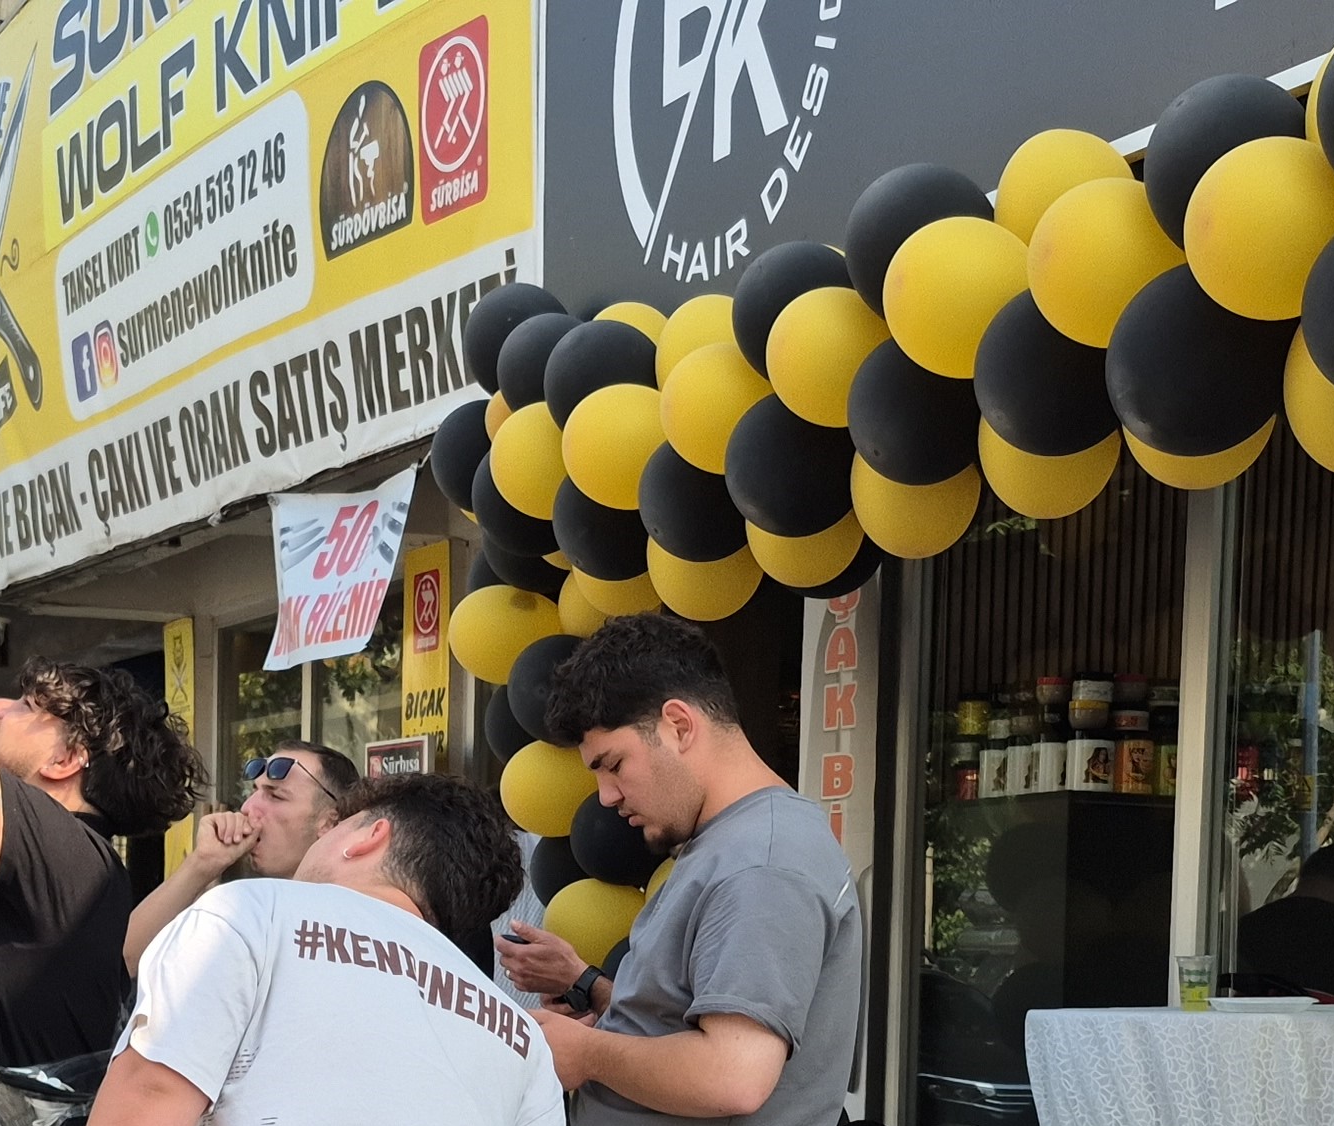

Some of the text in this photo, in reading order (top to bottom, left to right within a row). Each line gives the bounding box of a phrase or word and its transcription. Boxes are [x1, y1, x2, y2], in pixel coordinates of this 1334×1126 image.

[57, 38, 195, 225] WOLF
[62, 132, 285, 316] TANSEL KURT 0534 513 72 46
[331, 190, 407, 252] SÜRDÖVBİSA
[430, 169, 479, 213] SÜRBİSA
[117, 219, 298, 369] surmenewolfknife
[662, 217, 750, 283] HAIR
[13, 461, 82, 557] BIÇAK
[88, 431, 152, 537] ÇAKI
[145, 415, 183, 501] VE
[179, 379, 251, 489] ORAK
[249, 339, 349, 458] SATIŞ
[405, 686, 445, 727] BIÇAK
